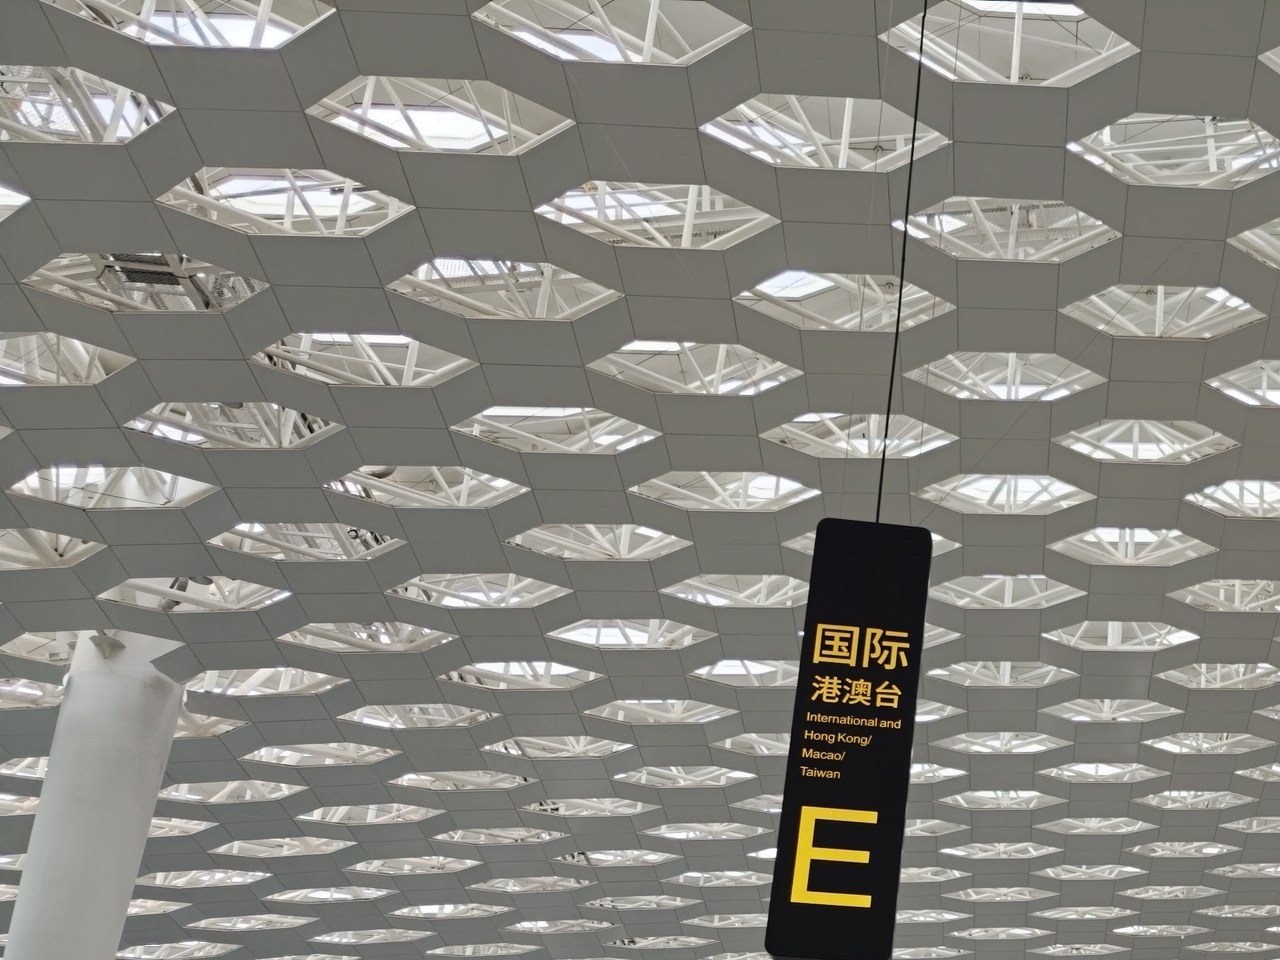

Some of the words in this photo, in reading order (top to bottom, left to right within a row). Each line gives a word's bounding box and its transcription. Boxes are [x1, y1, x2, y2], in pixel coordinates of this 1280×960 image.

[812, 623, 911, 670] 国际
[811, 675, 903, 709] 港澳台
[806, 712, 877, 728] International
[879, 717, 902, 729] and
[804, 730, 836, 745] Hong
[837, 733, 872, 747] Kong/
[802, 748, 845, 762] Macao/
[800, 766, 841, 779] Taiwan
[790, 805, 879, 908] E
